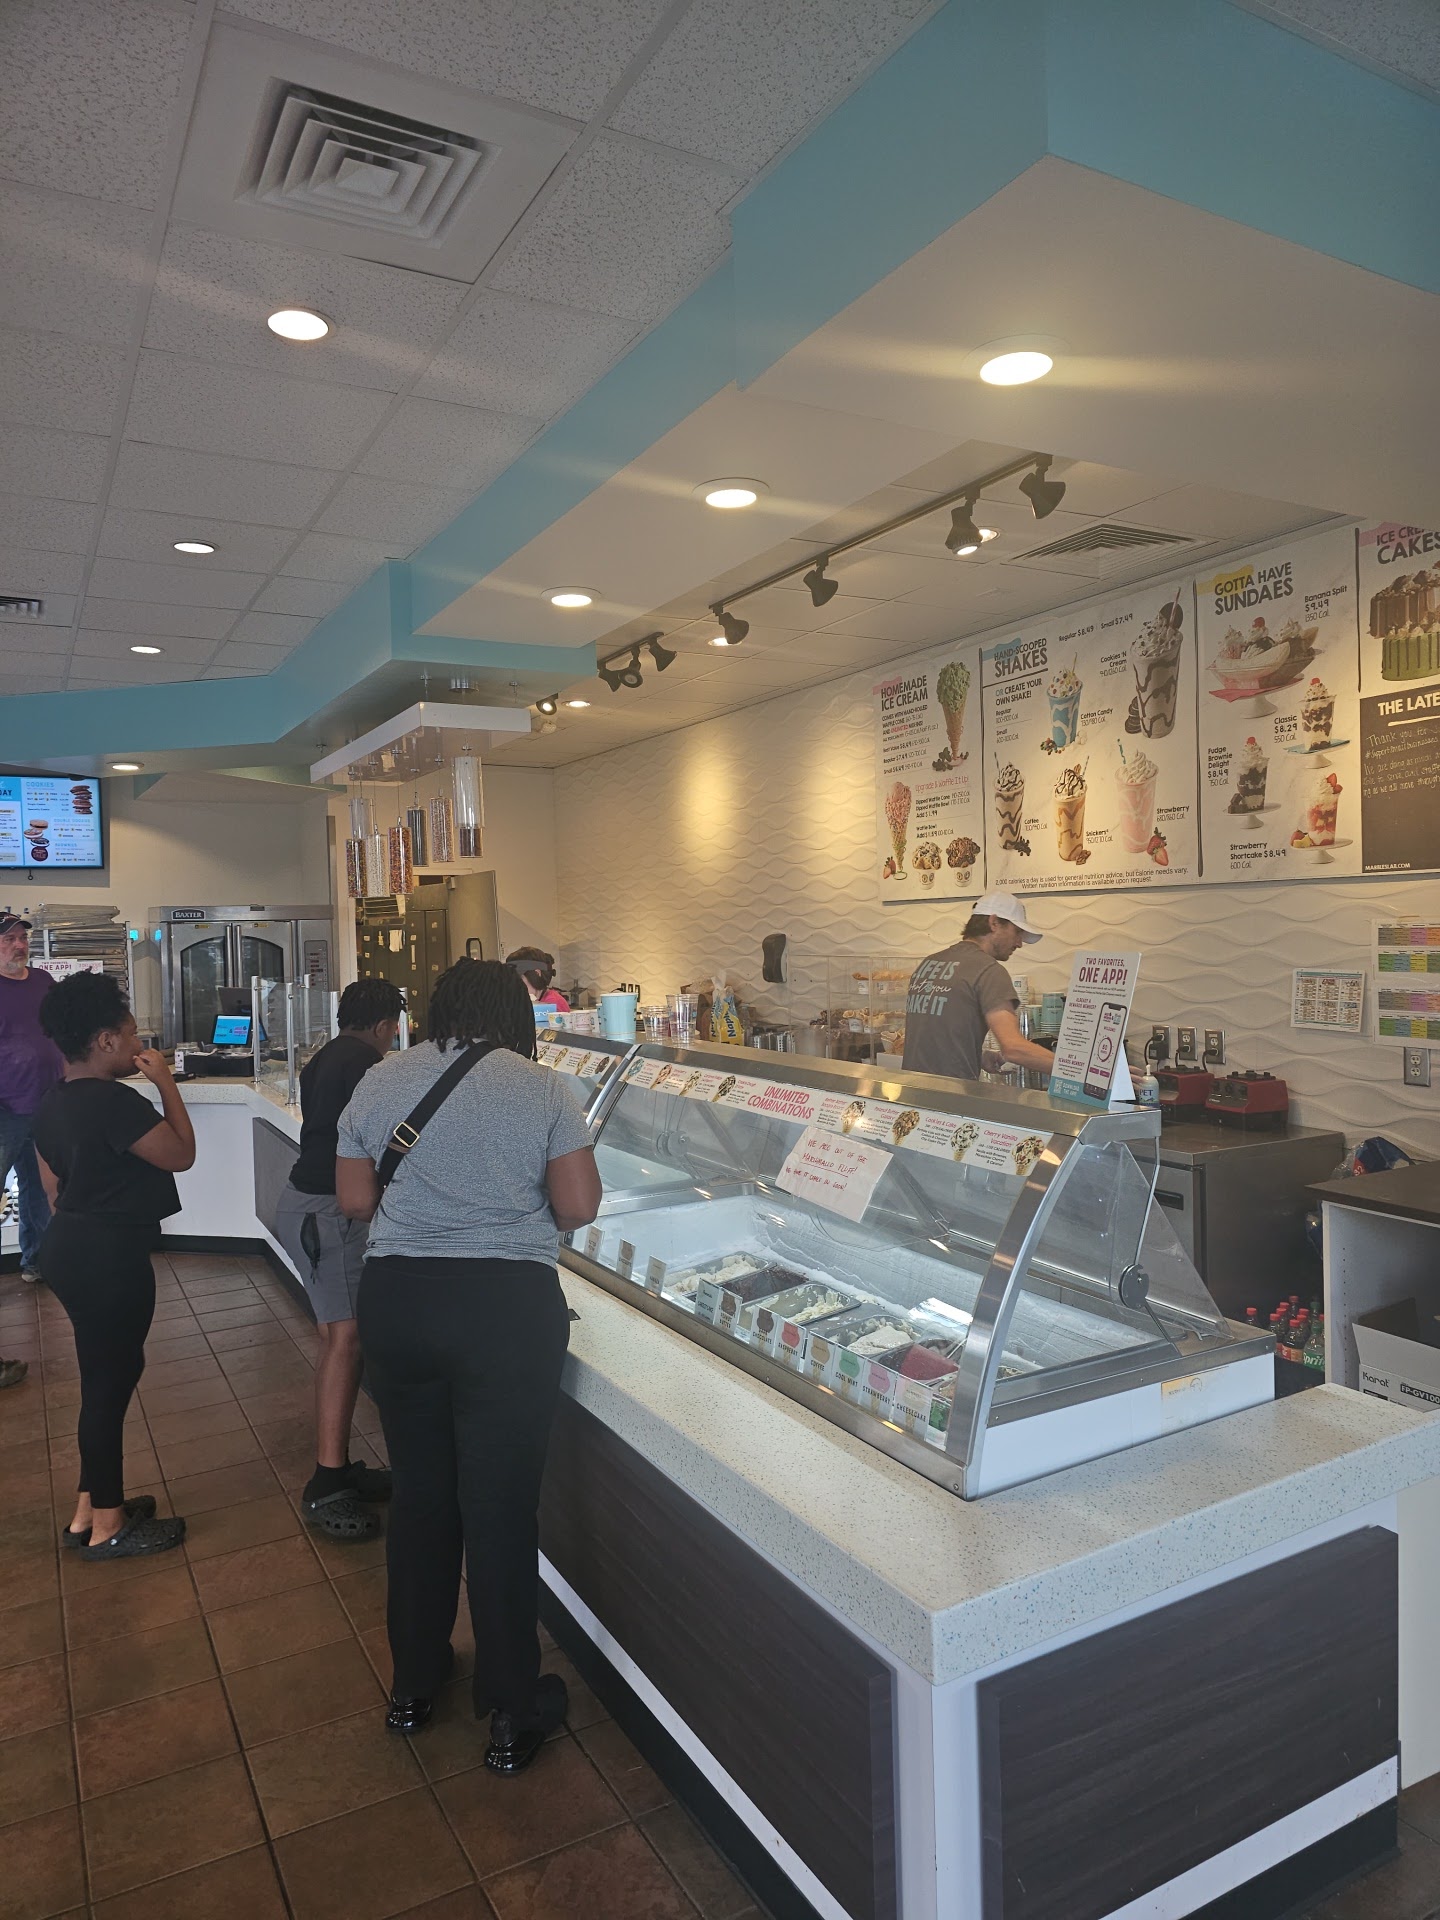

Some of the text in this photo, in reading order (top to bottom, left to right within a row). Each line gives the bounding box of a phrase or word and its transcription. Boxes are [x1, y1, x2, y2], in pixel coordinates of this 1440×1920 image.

[1377, 530, 1395, 546] ICE
[1215, 562, 1292, 596] GOTTA HAVE
[1215, 577, 1294, 616] SUNDAES
[1305, 585, 1347, 602] Banana Split
[1305, 599, 1329, 613] $9.49
[1059, 632, 1077, 642] Regular
[1101, 620, 1114, 630] Small
[1115, 613, 1133, 625] $7.49
[994, 638, 1047, 661] HAND-SCOOPED
[995, 648, 1048, 678] SHAKES
[1101, 654, 1121, 663] Cookies
[1110, 659, 1127, 668] Cream
[881, 675, 927, 698] HOMEMADE
[996, 678, 1042, 697] OR CREATE YOUR
[882, 688, 928, 711] ICE CREAM
[996, 691, 1032, 706] OWN SHAKE!
[1081, 708, 1113, 720] Cotton Candy
[1378, 699, 1403, 716] THE
[1274, 714, 1297, 724] Classic
[1274, 723, 1298, 734] $8.29
[1366, 732, 1397, 747] Thank
[1400, 730, 1412, 743] you
[1208, 746, 1226, 755] Fudge
[1208, 753, 1232, 762] Brownie
[1208, 760, 1229, 769] Delight
[1208, 769, 1228, 778] $8.49
[1157, 805, 1189, 815] Strawberry
[1230, 842, 1268, 851] Strawberry
[1230, 849, 1286, 860] Shortcake $8.49
[1098, 958, 1124, 967] FAVORITES,
[940, 962, 960, 980] IS
[1079, 967, 1128, 985] ONE APP!
[930, 996, 947, 1015] IT
[764, 1086, 810, 1104] UNLIMITED
[748, 1095, 814, 1119] COMBINATIONS
[926, 1117, 942, 1125] Cookies
[984, 1130, 1001, 1138] Cherry
[753, 1331, 772, 1345] CHOCOLATE
[778, 1342, 798, 1356] RASPBERRY
[811, 1360, 825, 1371] COFFEE
[835, 1372, 858, 1387] COOL MINT
[1363, 1372, 1389, 1387] Karat
[863, 1386, 890, 1405] STRAWBERRY
[897, 1402, 926, 1422] CHEESECAKE
